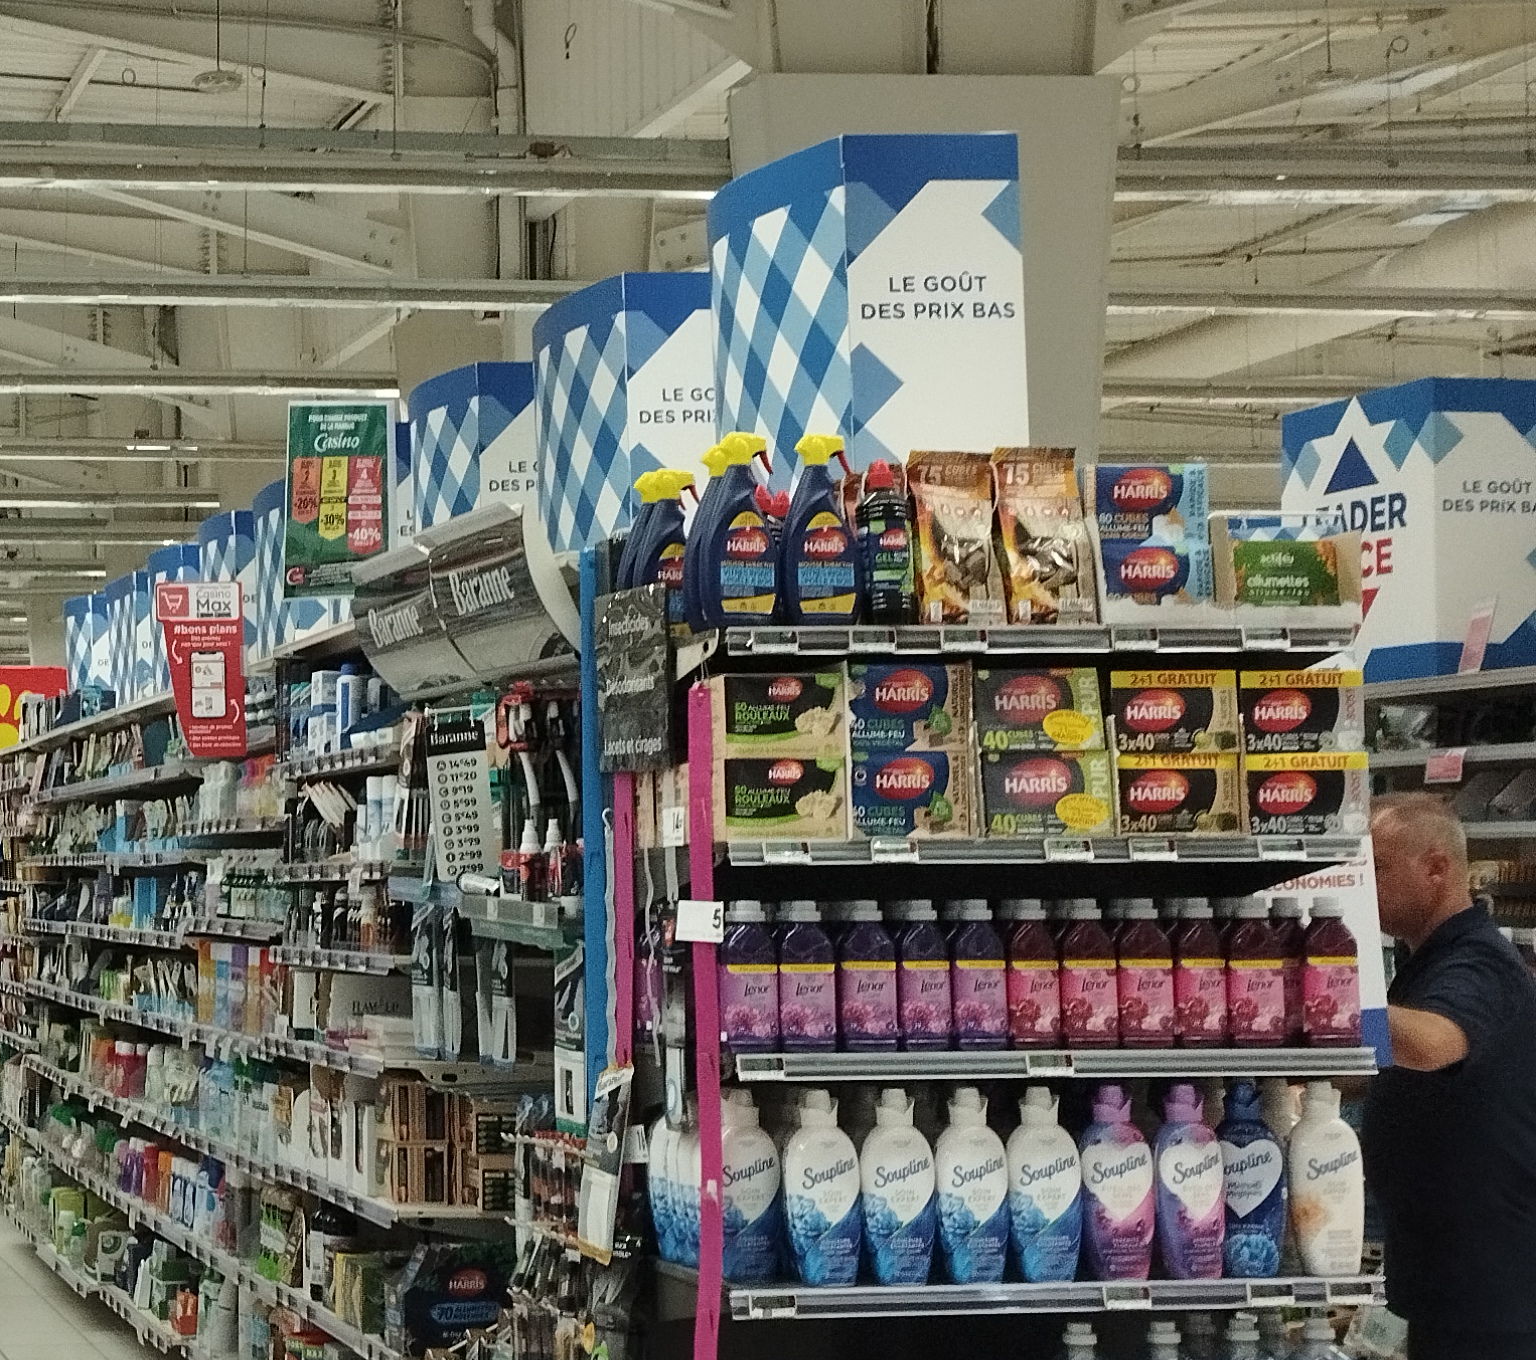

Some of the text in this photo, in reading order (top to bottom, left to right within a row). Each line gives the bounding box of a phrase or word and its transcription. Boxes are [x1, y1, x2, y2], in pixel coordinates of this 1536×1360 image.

[890, 271, 987, 293] LE GOÛT
[862, 302, 1015, 319] DES PRIX BAS
[662, 388, 716, 402] LE GO
[640, 410, 717, 423] DES PRI
[314, 432, 359, 452] Casino
[509, 461, 527, 473] LE
[490, 480, 519, 491] DES
[1114, 485, 1167, 500] HARRIS
[1463, 478, 1532, 493] LE GOÛT
[1442, 499, 1536, 512] DES PRIX BA
[1121, 565, 1175, 579] HARRIS
[449, 566, 514, 616] Baranne
[197, 599, 231, 611] Max
[368, 606, 423, 648] Baranne
[1157, 673, 1216, 685] GRATUIT
[1286, 673, 1343, 685] GRATUIT
[769, 686, 801, 696] HARRIS
[876, 685, 929, 701] HARRIS
[995, 694, 1056, 711] HARRIS
[1126, 705, 1181, 719] HARRIS
[1255, 706, 1307, 720] HARRIS
[984, 731, 1008, 749] 40
[769, 768, 801, 779] HARRIS
[876, 773, 929, 789] HARRIS
[1005, 778, 1067, 793] HARRIS
[1130, 786, 1185, 801] HARRIS
[1265, 874, 1356, 892] CONOMIES
[723, 1154, 775, 1188] Soupline
[1020, 1155, 1076, 1187] Soupline
[1091, 1153, 1148, 1184] Soupline
[1224, 1151, 1272, 1176] oupline
[1307, 1150, 1358, 1181] Soupline
[802, 1155, 856, 1190] Soupline
[875, 1155, 930, 1189] Soupline
[951, 1155, 1004, 1189] Soupline
